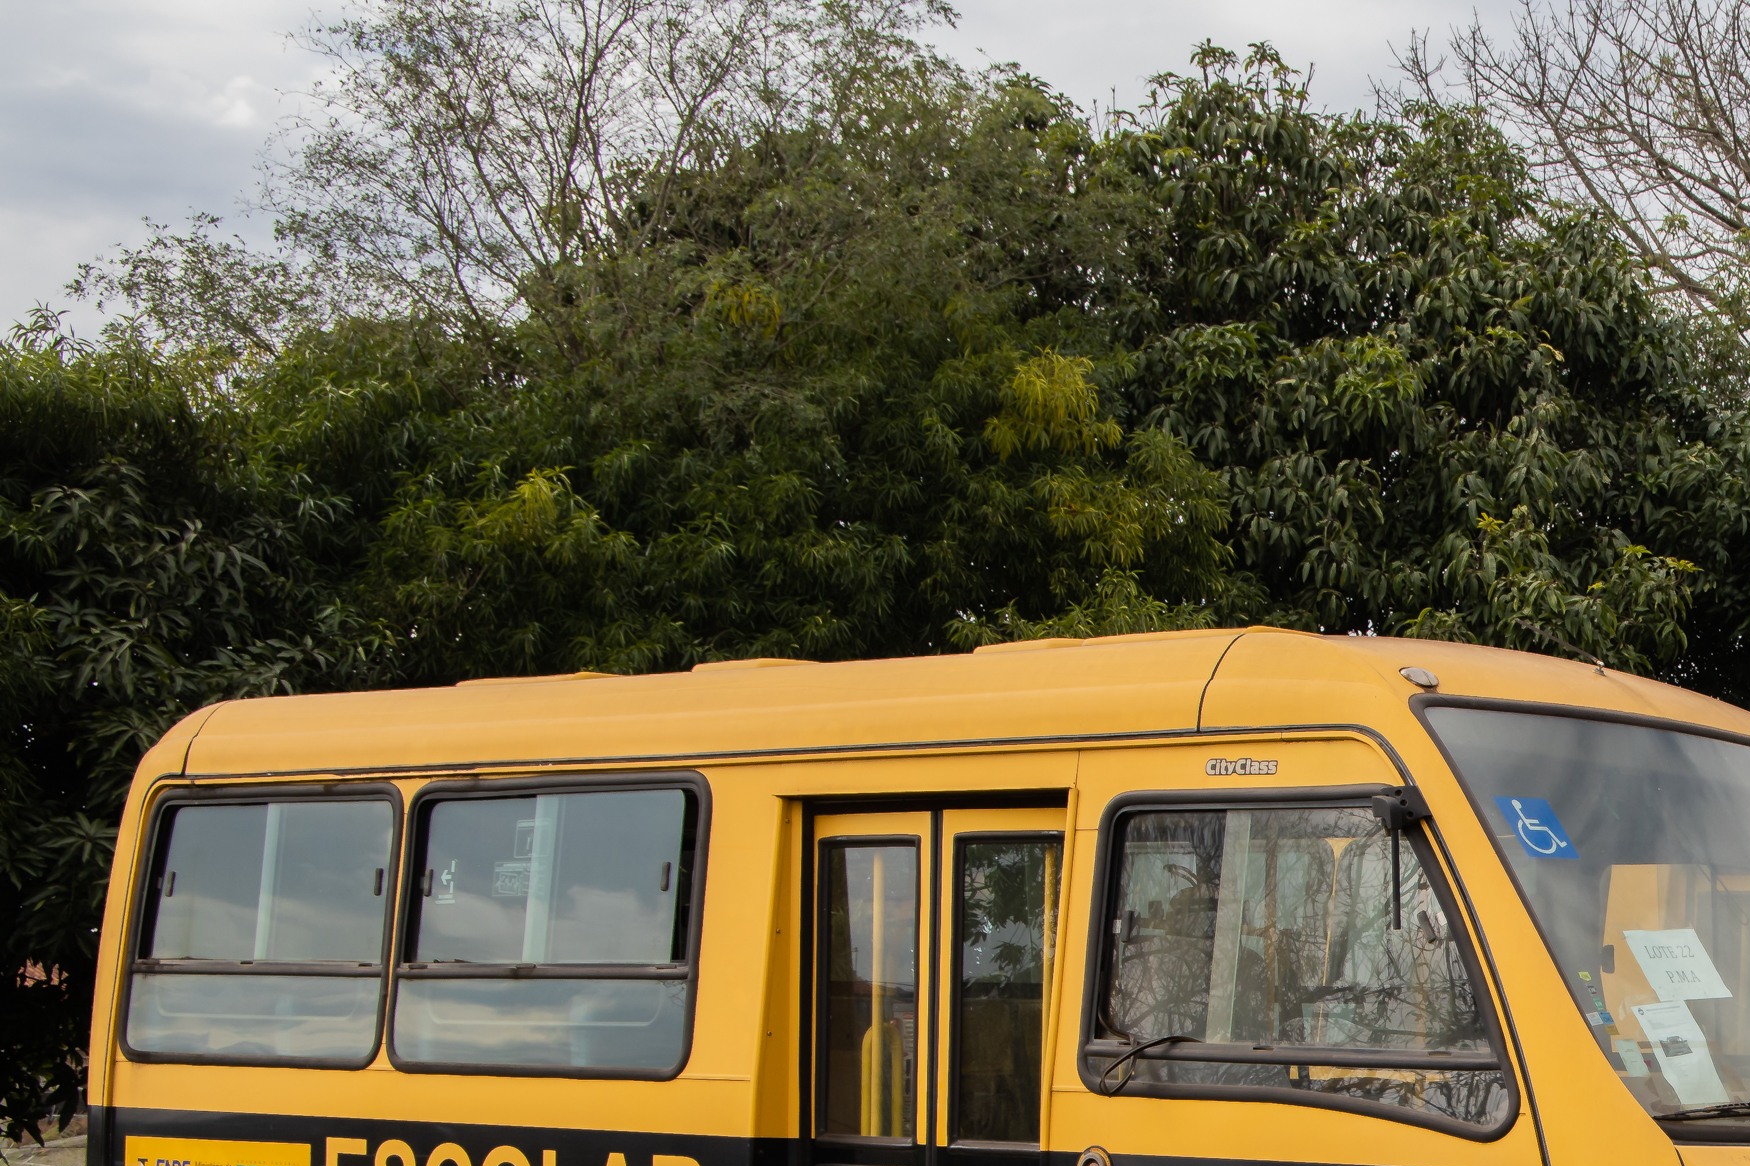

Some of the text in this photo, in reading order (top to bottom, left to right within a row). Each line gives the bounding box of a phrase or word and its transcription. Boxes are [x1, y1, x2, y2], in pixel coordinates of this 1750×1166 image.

[1205, 757, 1278, 776] CityClass
[1644, 945, 1695, 960] LOTE 22
[1665, 970, 1702, 983] P.M.A
